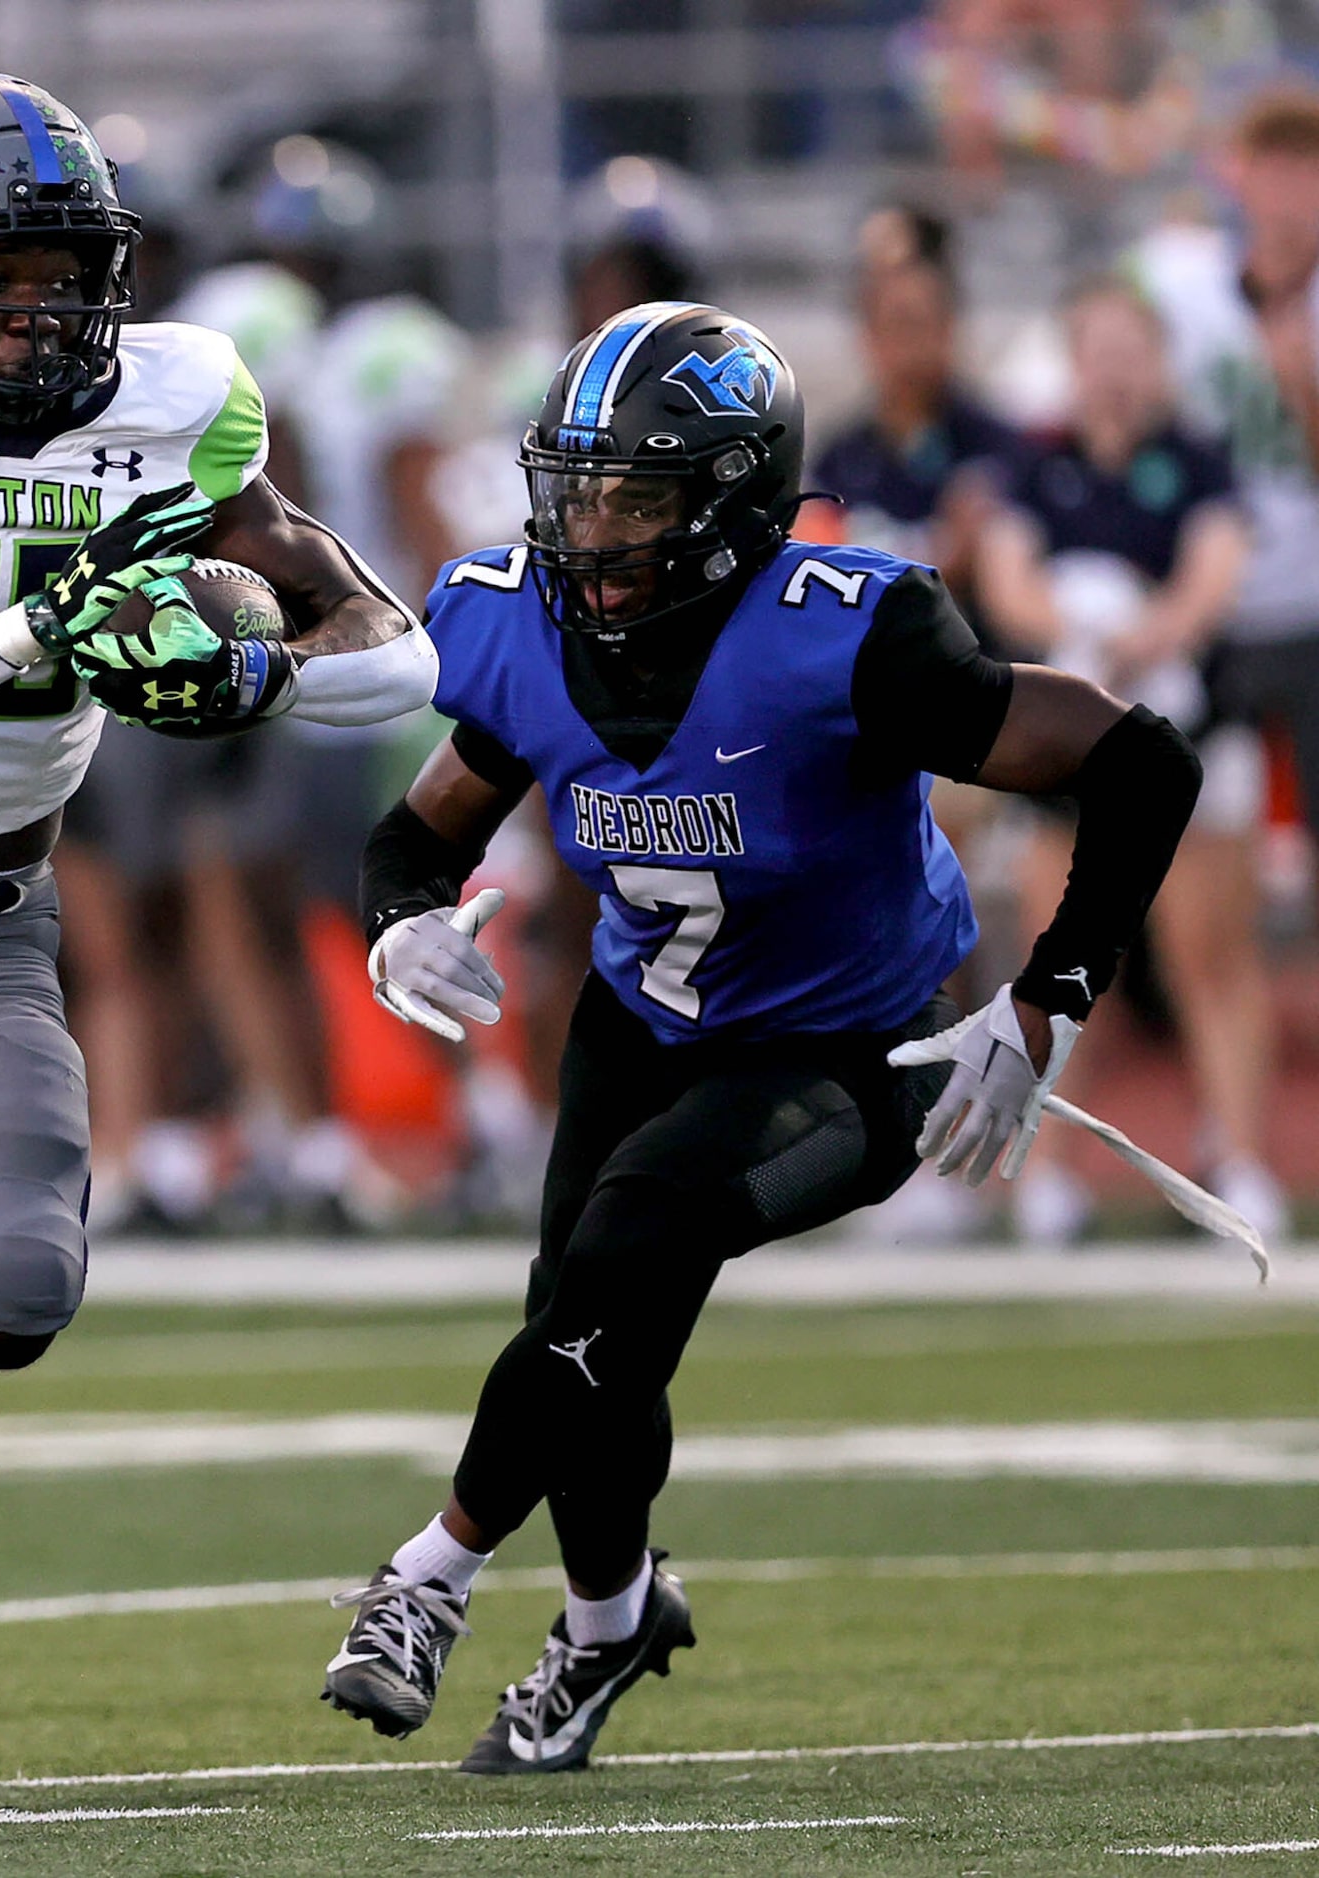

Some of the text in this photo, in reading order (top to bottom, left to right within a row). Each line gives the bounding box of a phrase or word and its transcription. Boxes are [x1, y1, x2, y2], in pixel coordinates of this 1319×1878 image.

[445, 544, 531, 594] 7
[777, 556, 872, 610] 7
[230, 651, 240, 687] MORE
[570, 782, 745, 857] HEBRON
[605, 862, 727, 1022] 7
